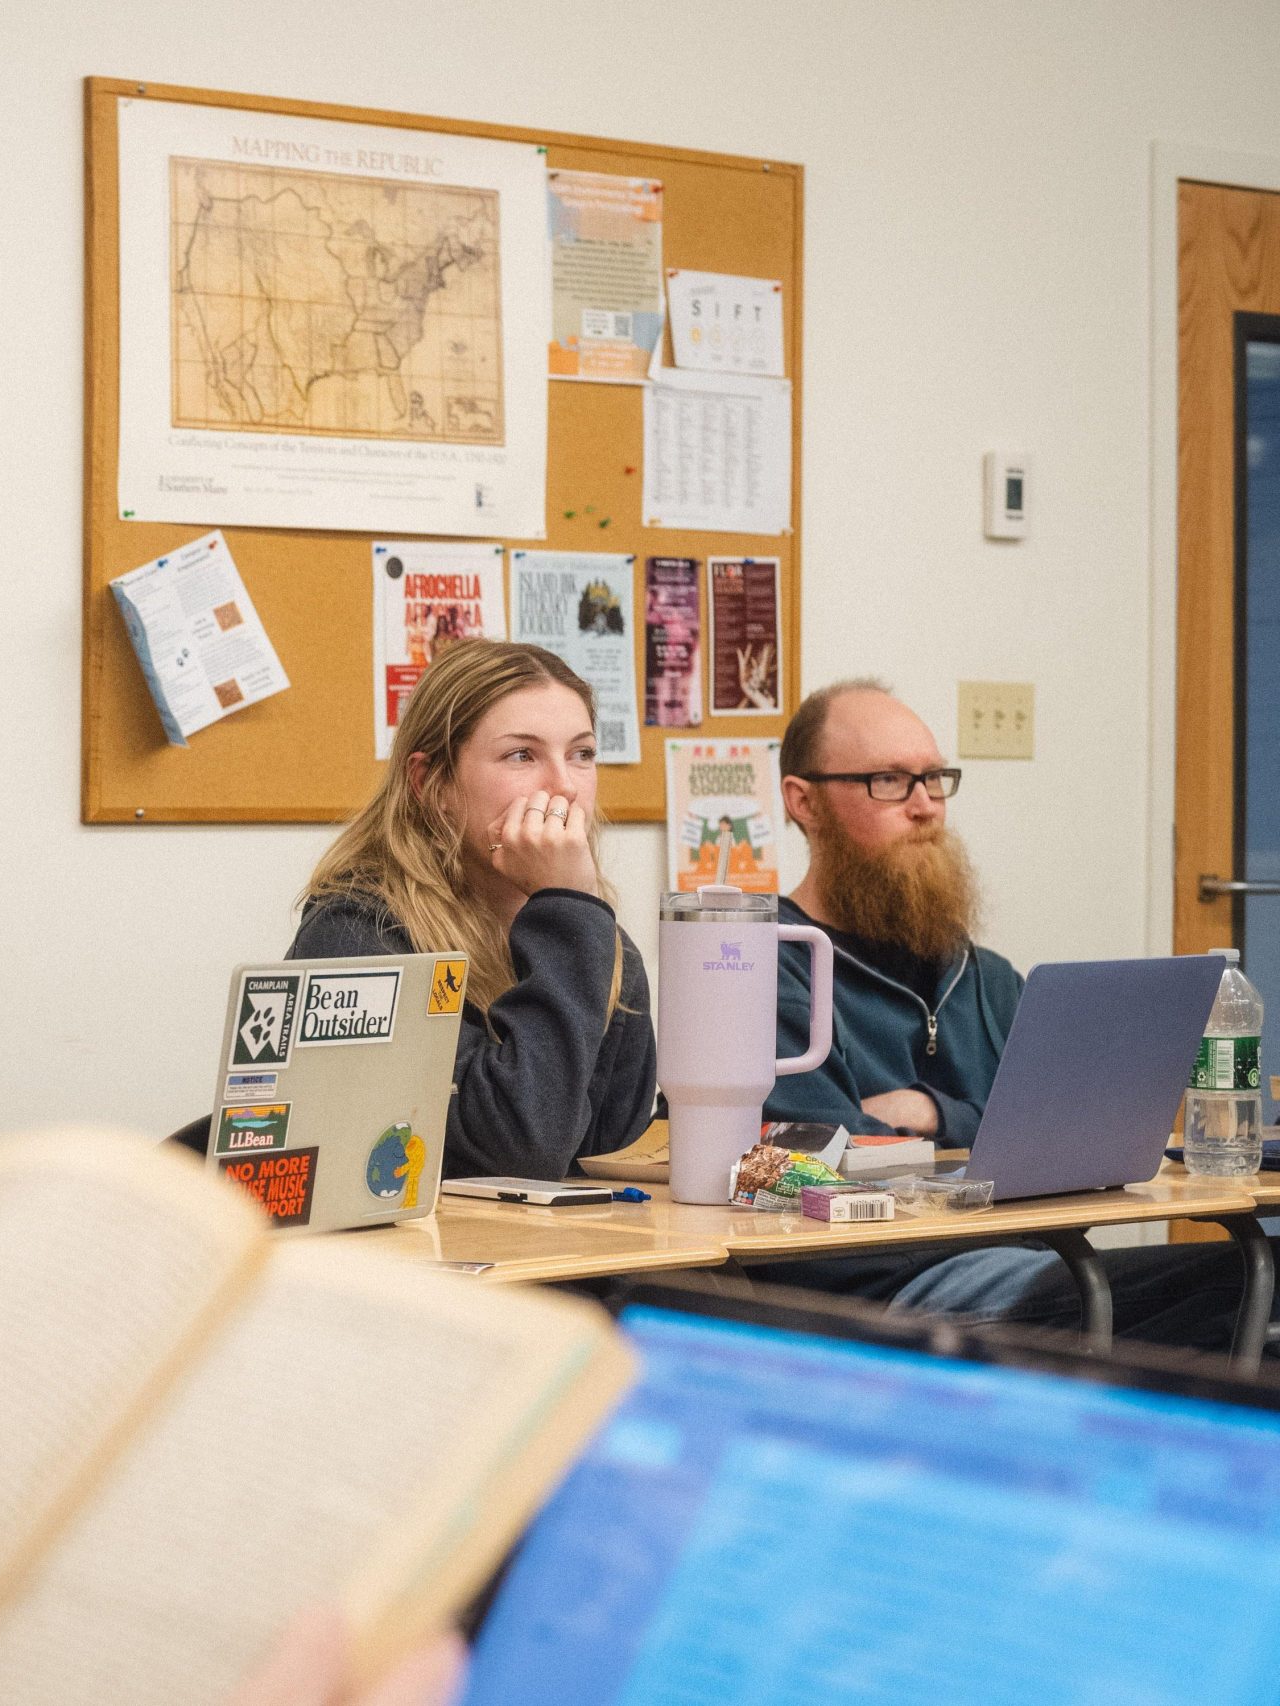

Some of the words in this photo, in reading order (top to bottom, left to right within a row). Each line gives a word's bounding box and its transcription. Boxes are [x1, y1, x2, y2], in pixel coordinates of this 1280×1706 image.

[231, 135, 321, 162] MAPPING
[323, 148, 354, 167] THE
[356, 147, 444, 177] REPUBLIC
[404, 573, 482, 600] AFROCHELLA
[688, 774, 756, 785] STUDENT
[689, 763, 754, 774] HONORS
[689, 784, 754, 796] COUNCIL
[702, 961, 755, 971] STANLEY
[248, 980, 289, 991] CHAMPLAIN
[308, 984, 332, 1010] Be
[334, 989, 359, 1009] an
[284, 993, 296, 1021] AREA
[304, 1009, 388, 1039] Outsider
[278, 1023, 292, 1058] TRAILS
[225, 1162, 255, 1182] NO
[258, 1155, 310, 1178] MORE
[267, 1174, 308, 1201] MUSIC
